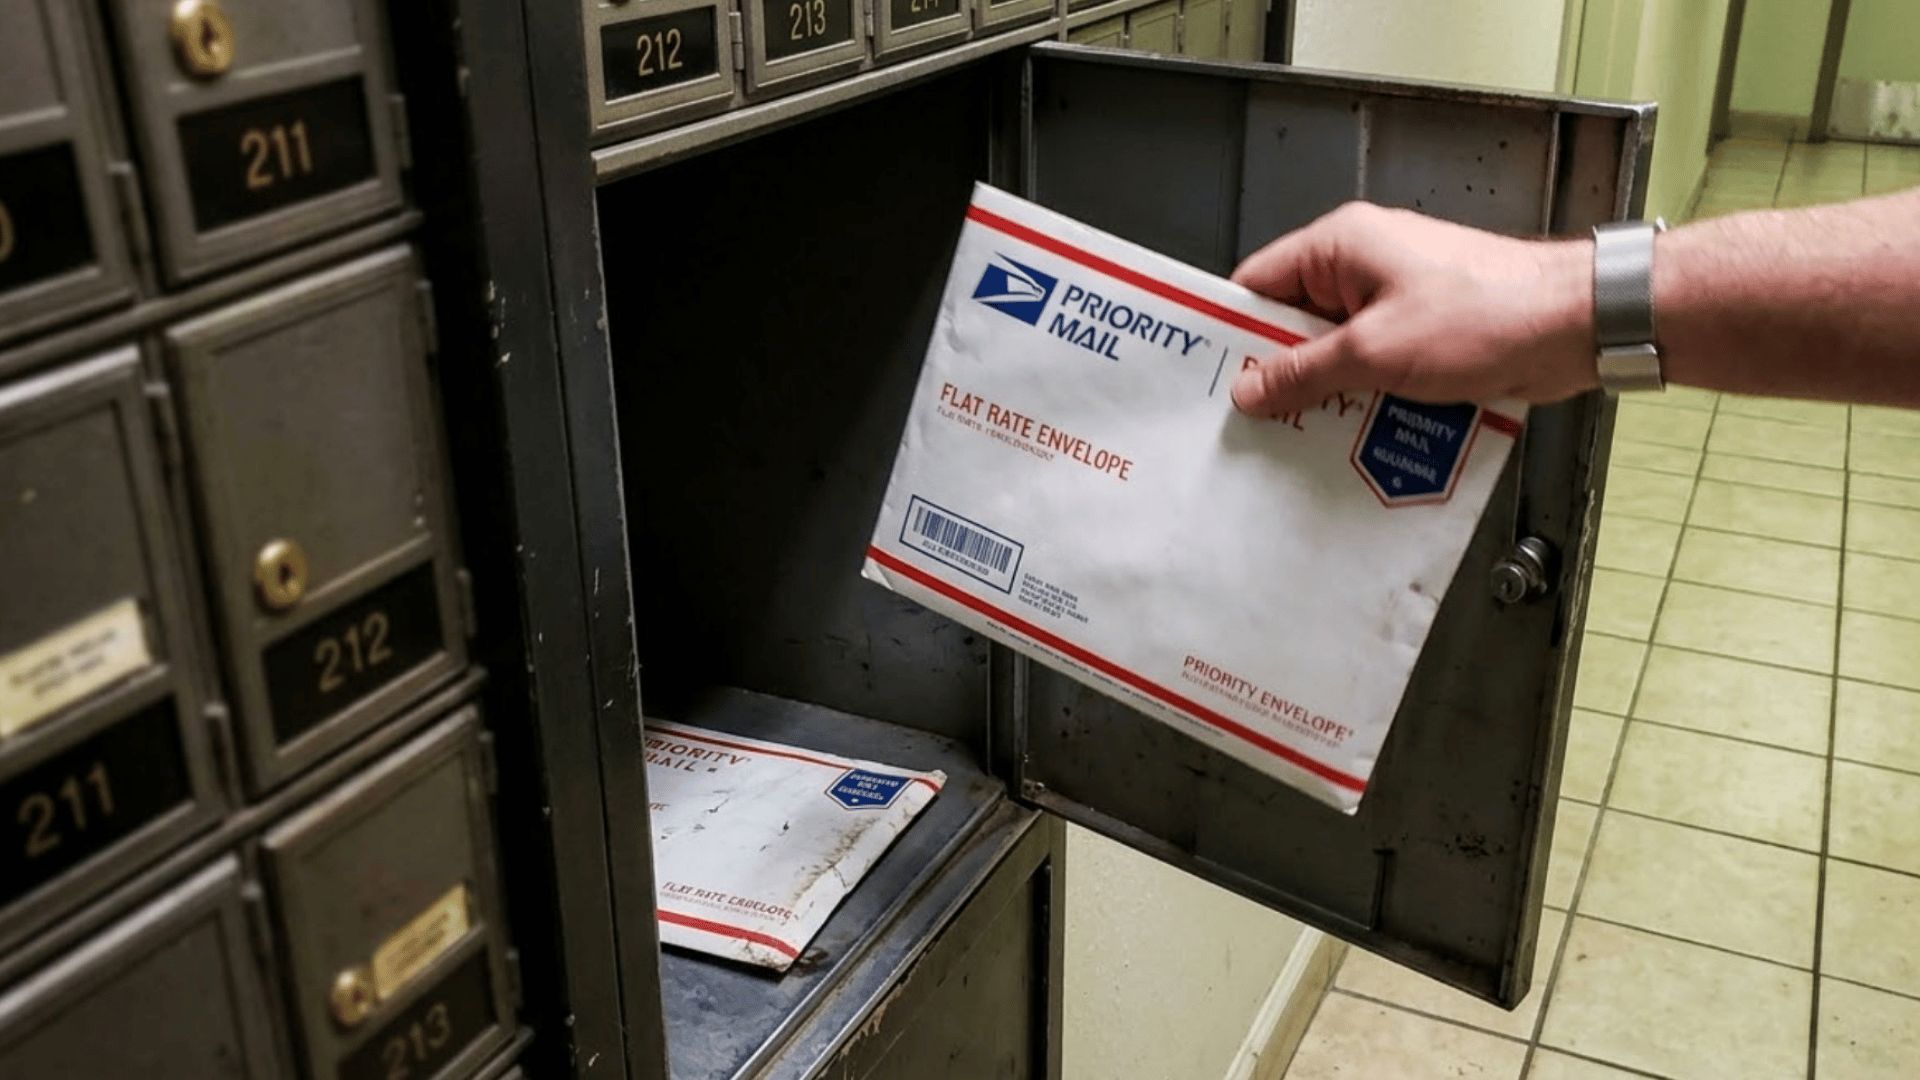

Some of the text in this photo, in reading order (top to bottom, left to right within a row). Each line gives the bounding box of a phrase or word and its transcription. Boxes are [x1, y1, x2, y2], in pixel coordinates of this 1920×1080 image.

[637, 28, 683, 77] 212
[790, 0, 827, 40] 213
[241, 121, 313, 189] 211
[1048, 312, 1120, 361] MAIL
[1061, 284, 1203, 356] PRIORITY
[940, 382, 984, 416] FLAT
[986, 403, 1035, 438] RATE
[1036, 424, 1134, 481] ENVELOPE
[316, 611, 393, 693] 212
[1184, 655, 1258, 698] PRIORITY
[17, 762, 114, 858] 211
[381, 1002, 451, 1080] 213
